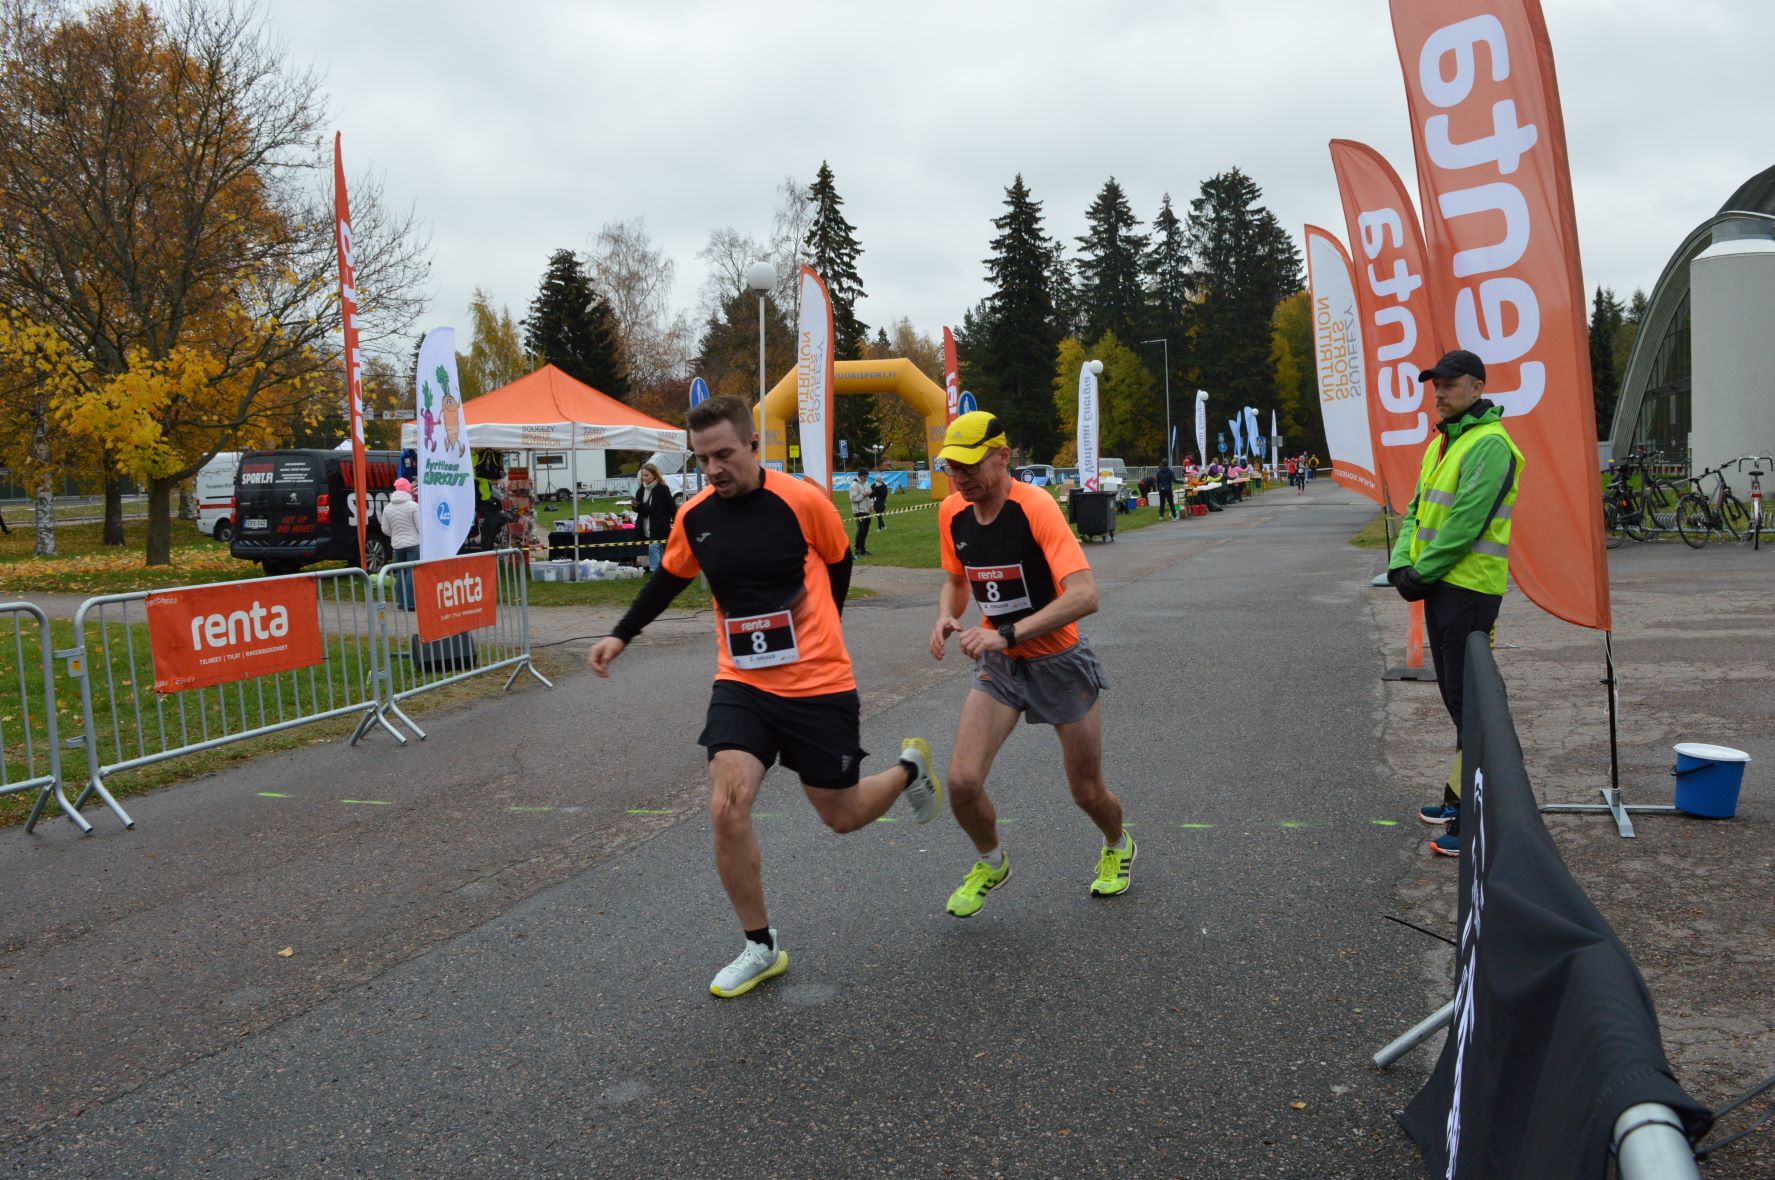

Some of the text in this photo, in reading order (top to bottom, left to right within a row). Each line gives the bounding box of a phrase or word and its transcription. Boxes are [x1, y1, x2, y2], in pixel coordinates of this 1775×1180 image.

[840, 440, 846, 448] P
[242, 472, 274, 485] SPORT.FI
[978, 569, 1004, 579] renta
[437, 572, 483, 609] renta
[986, 581, 1000, 602] 8
[191, 601, 289, 651] renta
[751, 631, 768, 654] 8
